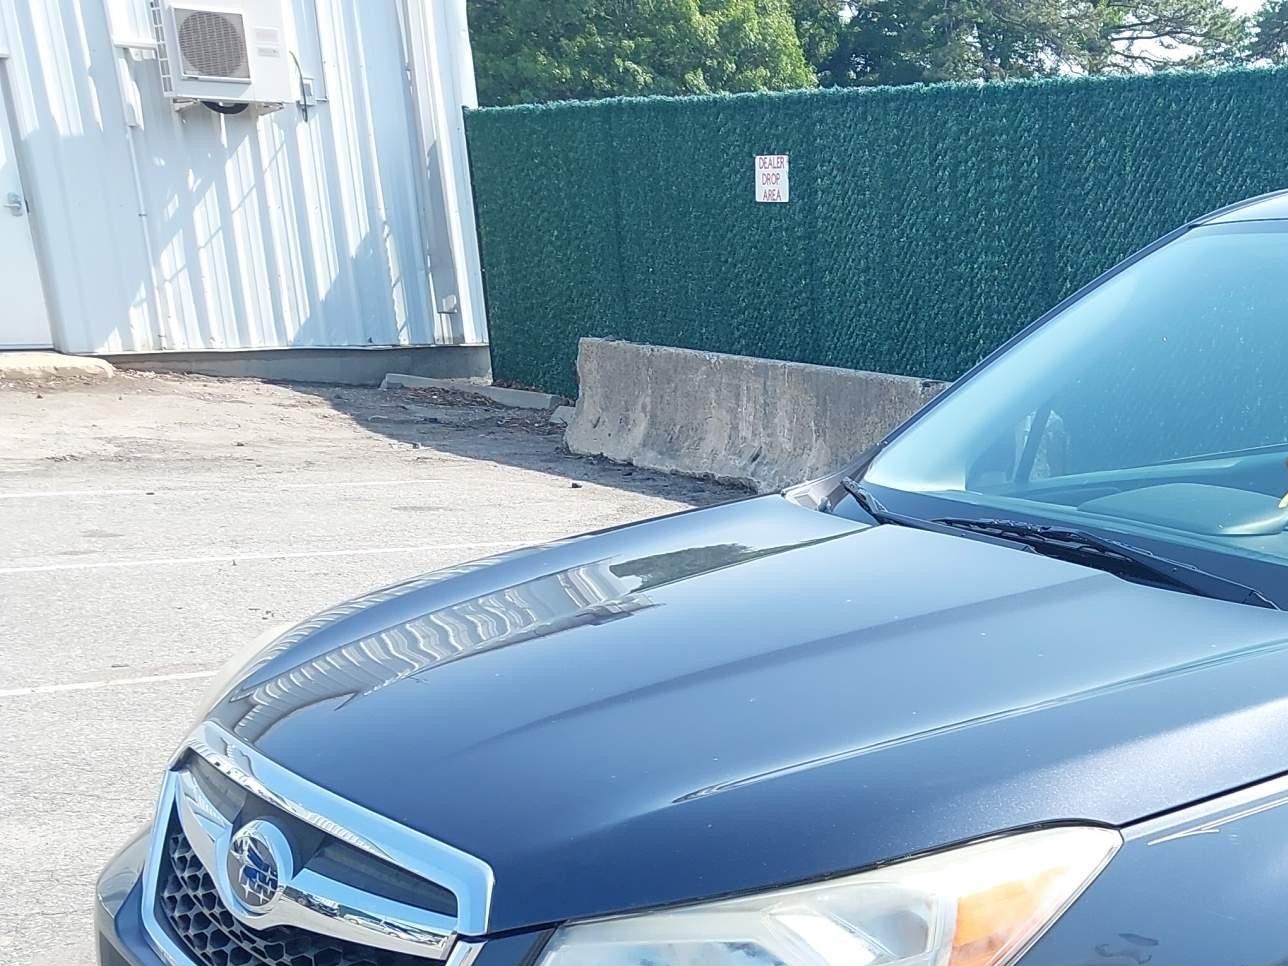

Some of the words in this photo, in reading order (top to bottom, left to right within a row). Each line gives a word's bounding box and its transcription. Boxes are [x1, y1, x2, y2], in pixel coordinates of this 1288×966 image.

[759, 157, 785, 169] DEALER
[762, 173, 781, 185] DROP
[763, 189, 782, 201] AREA
